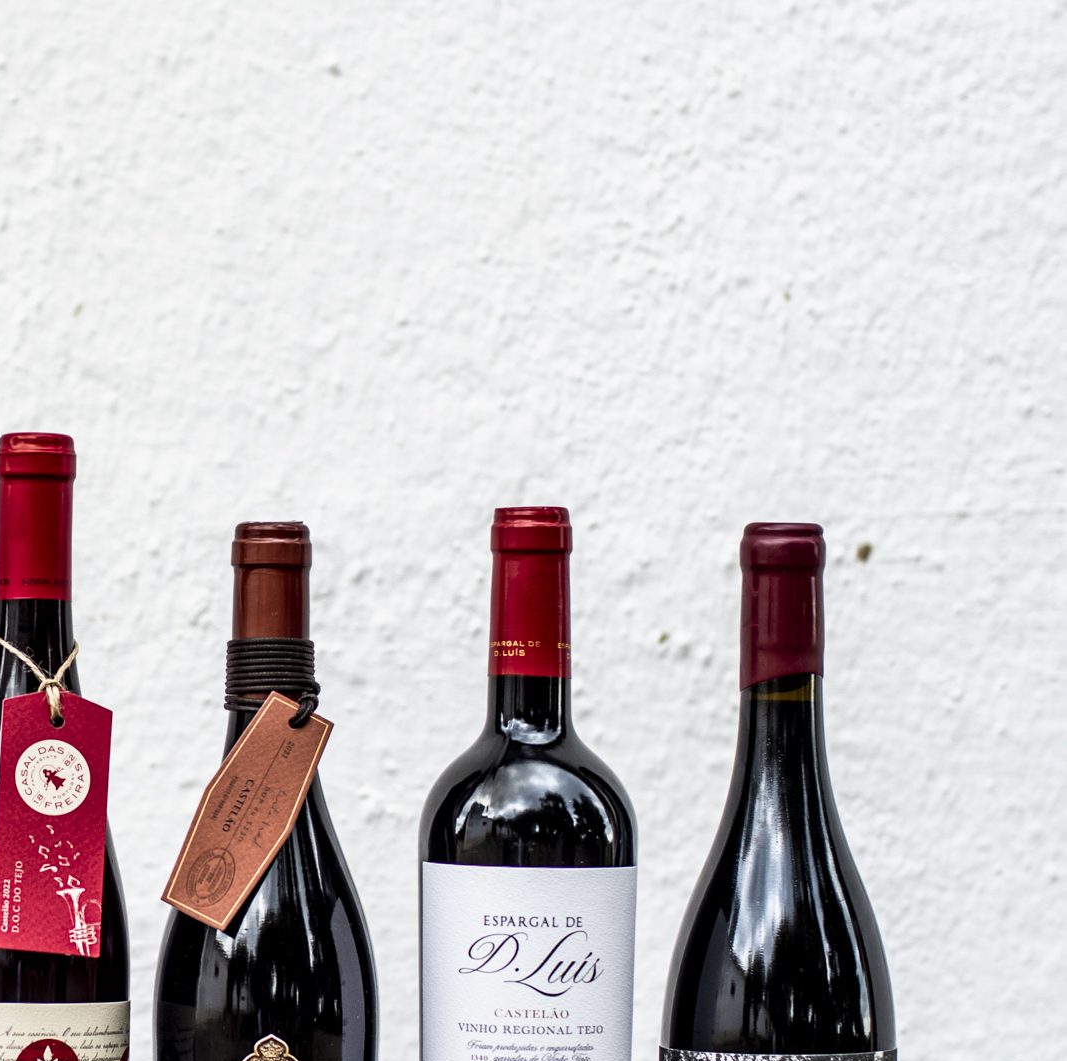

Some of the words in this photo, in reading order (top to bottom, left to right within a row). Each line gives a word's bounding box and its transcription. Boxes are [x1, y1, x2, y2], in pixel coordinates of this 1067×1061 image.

[502, 648, 526, 657] LUÍS
[527, 640, 541, 648] DE
[21, 756, 37, 796] CASAL
[38, 745, 65, 755] DAS
[64, 754, 76, 767] 82
[44, 763, 85, 810] FREIRAS
[221, 778, 255, 833] CASTELÃO
[14, 860, 24, 885] TEJO
[2, 879, 11, 899] 2022
[13, 887, 22, 903] DO
[1, 899, 10, 933] Castelão
[11, 905, 21, 933] D.O.C
[484, 914, 559, 928] ESPARGAL
[566, 916, 584, 928] DE
[503, 930, 605, 997] Luís
[494, 1007, 570, 1019] CASTELÃO
[458, 1022, 498, 1034] VINHO
[503, 1024, 573, 1036] REGIONAL
[577, 1024, 604, 1035] TEJO
